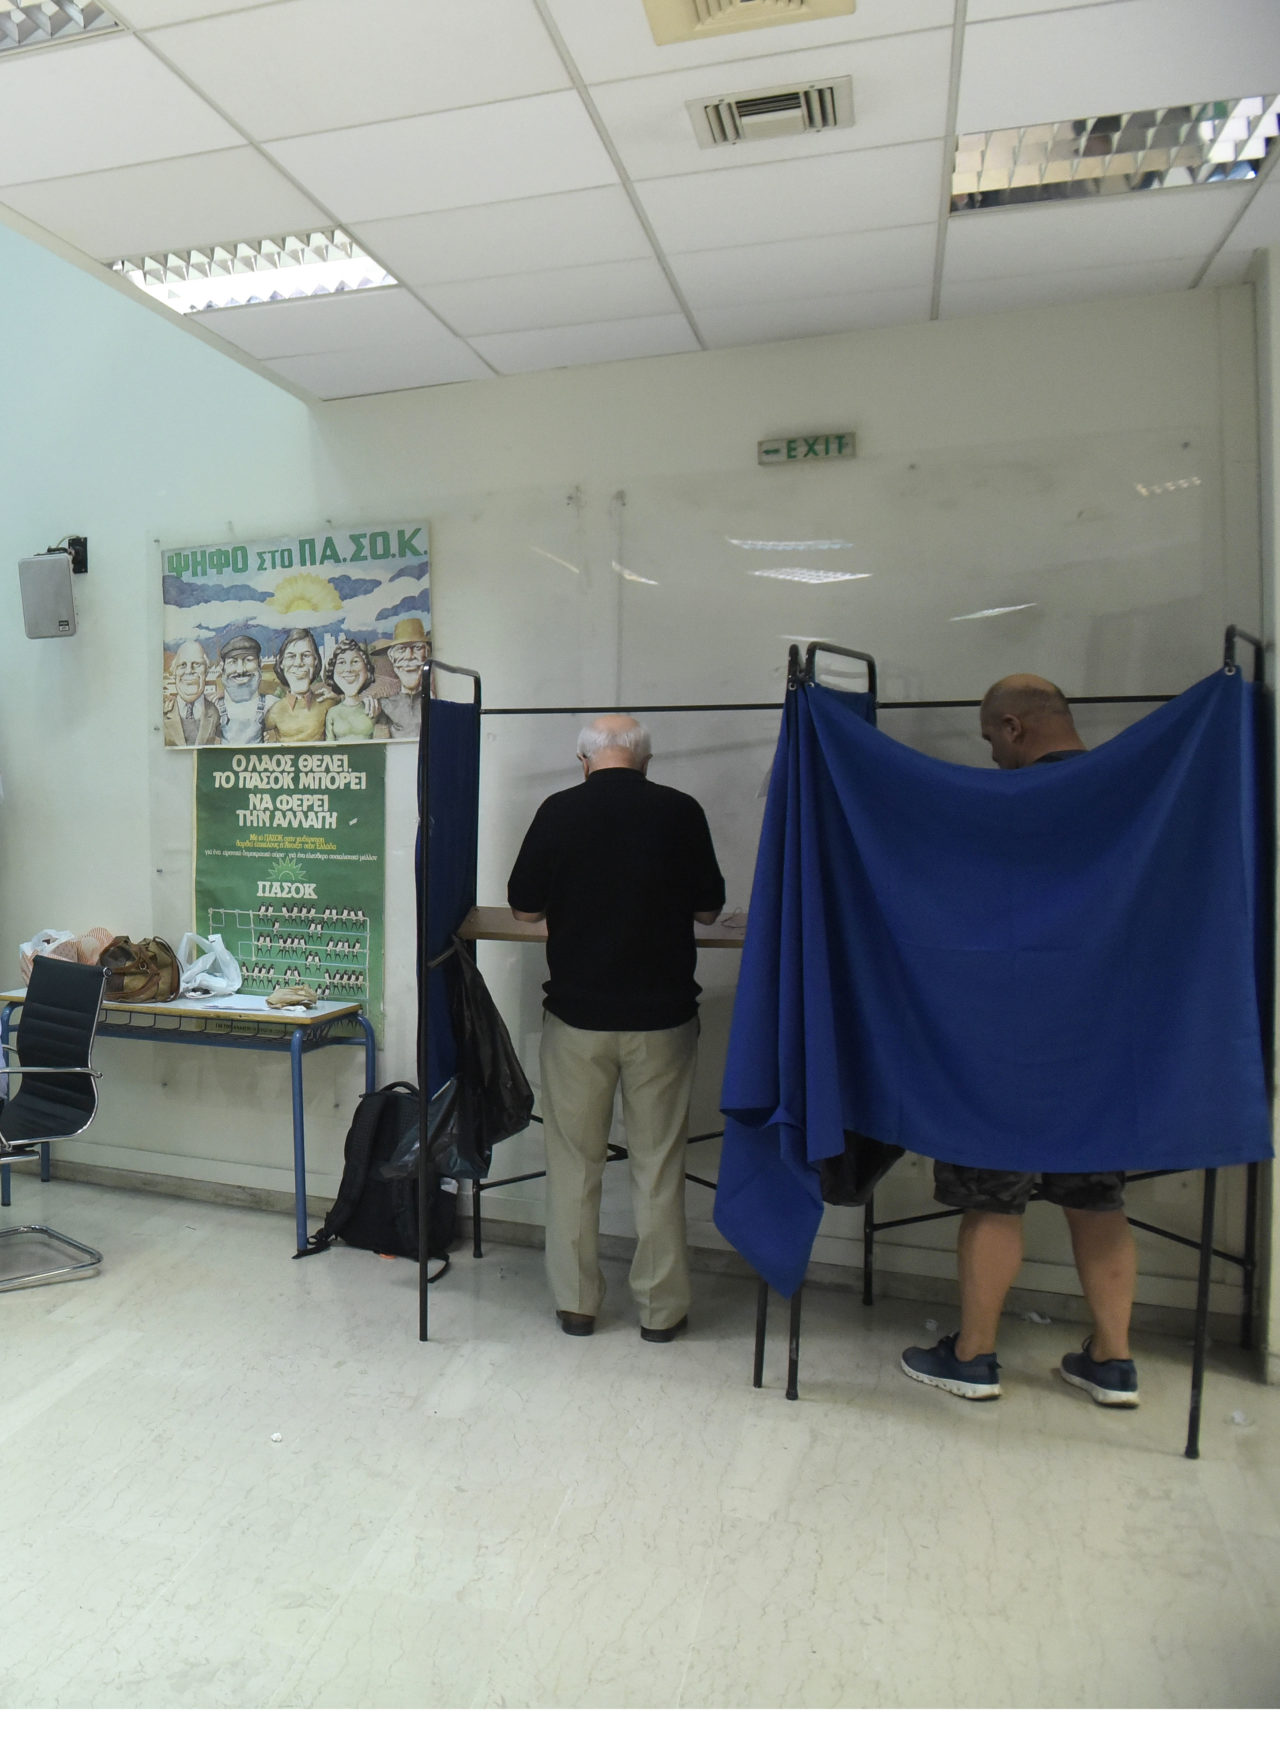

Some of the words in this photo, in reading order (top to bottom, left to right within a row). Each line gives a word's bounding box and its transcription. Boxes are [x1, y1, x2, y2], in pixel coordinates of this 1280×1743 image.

[786, 435, 846, 459] EXIT
[167, 545, 249, 579] ΨΗΦΟ
[257, 548, 293, 572] ΣΤΟ
[299, 527, 428, 567] ΠΑ.ΣΟ.Κ.
[232, 755, 246, 772] Ο
[249, 755, 295, 772] ΛΑΟΣ
[214, 773, 235, 788] ΤΟ
[239, 773, 295, 789] ΠΑΣΟΚ
[299, 772, 366, 789] ΜΠΟΡΕΙ
[249, 794, 273, 811] ΝΑ
[276, 794, 328, 811] ΦΕΡΕΙ
[237, 811, 270, 827] ΤΗΝ
[273, 811, 337, 828] ΑΛΛΑΓΗ
[257, 881, 318, 899] ΠΑΣΟΚ
